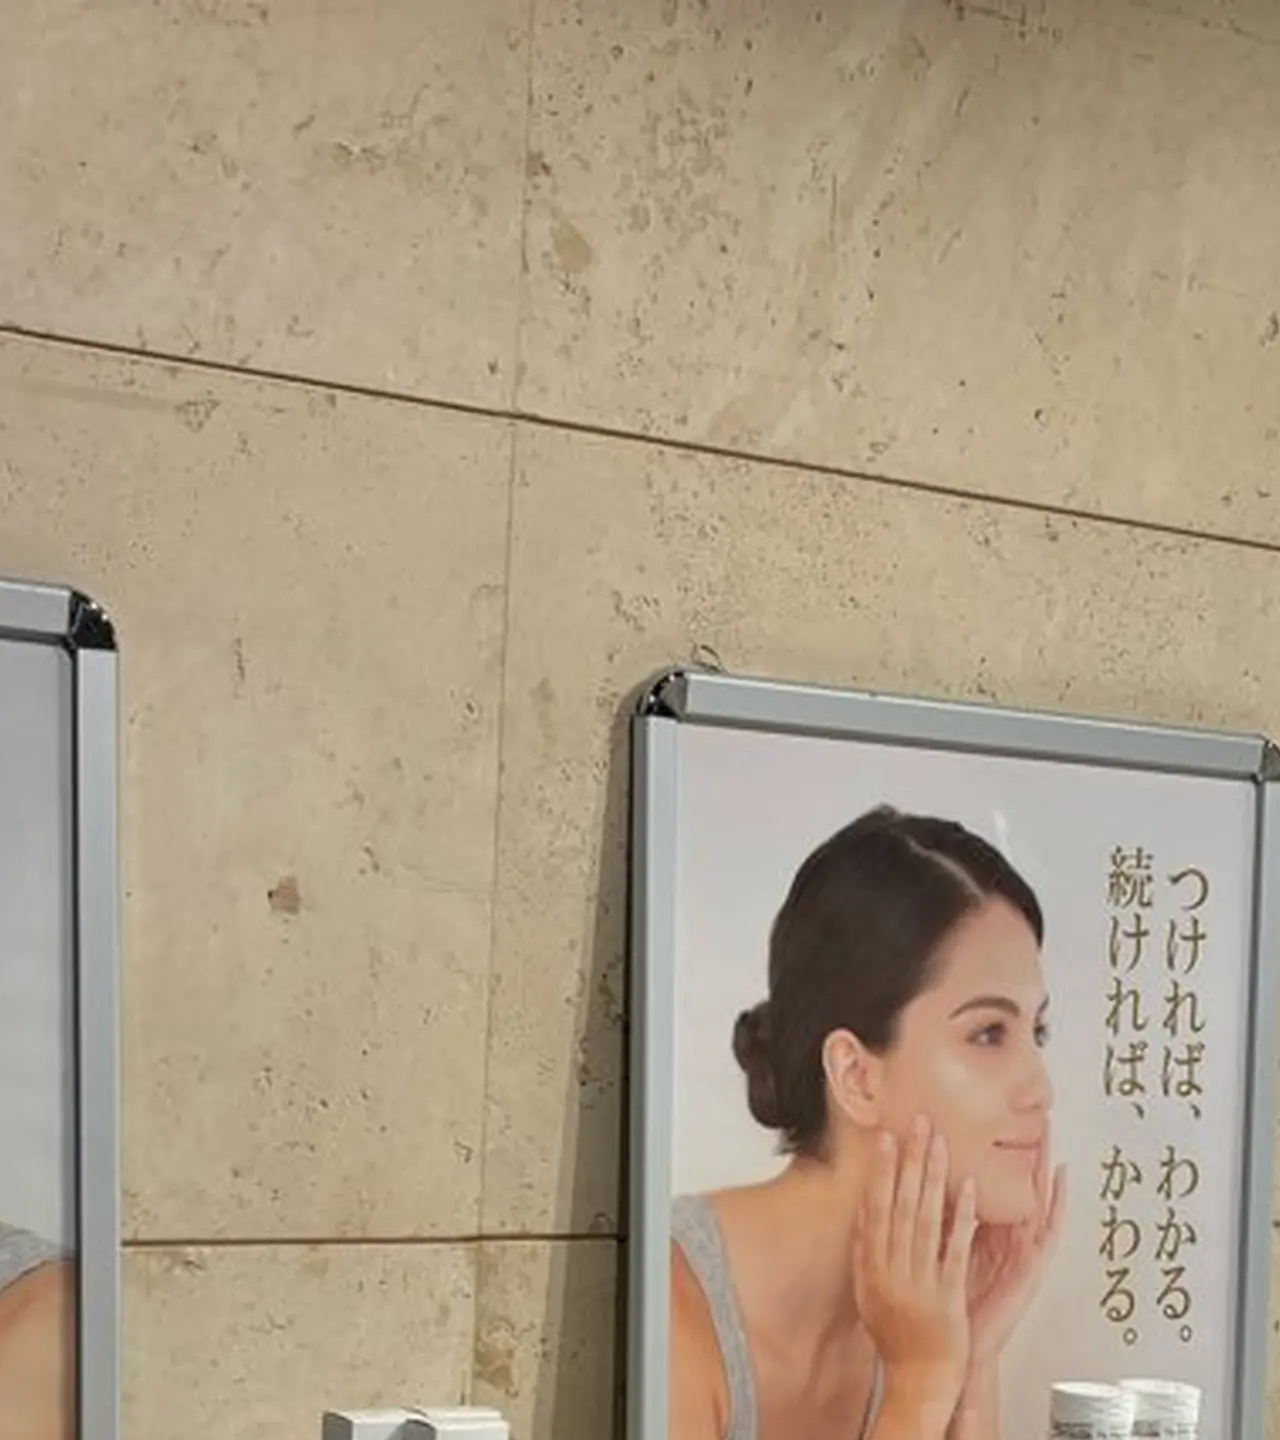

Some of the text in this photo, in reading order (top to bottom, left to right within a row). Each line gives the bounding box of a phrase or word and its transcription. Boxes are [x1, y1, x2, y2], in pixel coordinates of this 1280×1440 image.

[1099, 845, 1155, 1347] 続ければ、かわる。
[1155, 866, 1210, 1344] つければ、わかる。
